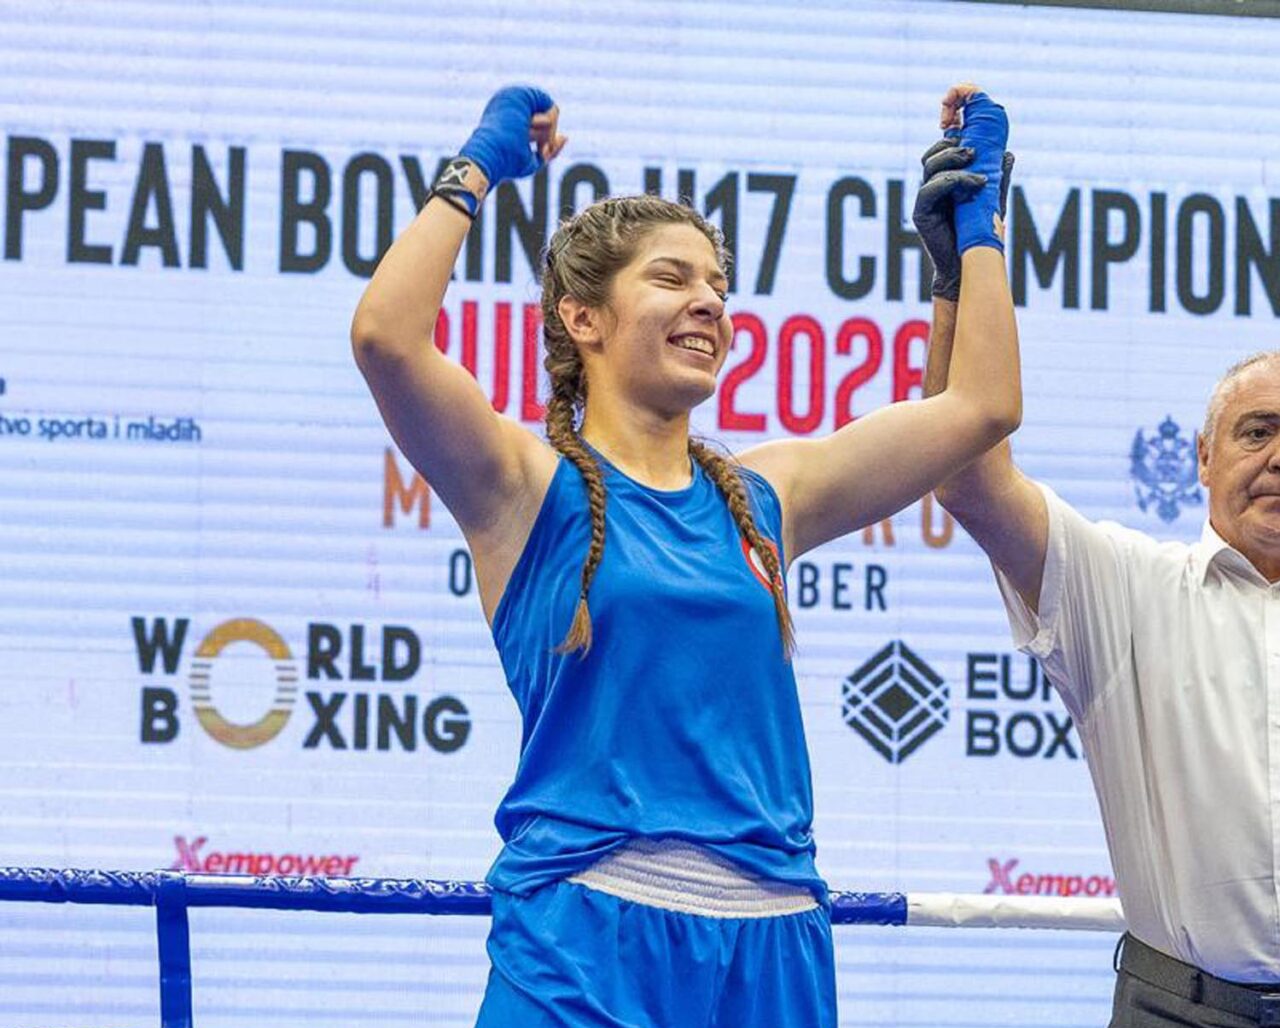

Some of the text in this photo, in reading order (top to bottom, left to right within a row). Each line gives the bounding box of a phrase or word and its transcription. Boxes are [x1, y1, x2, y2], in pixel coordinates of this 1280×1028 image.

[4, 135, 247, 270] PEAN
[644, 165, 797, 296] 17
[38, 417, 108, 442] sporta
[114, 414, 120, 438] i
[127, 416, 201, 442] mladih
[172, 835, 361, 876] Xempower
